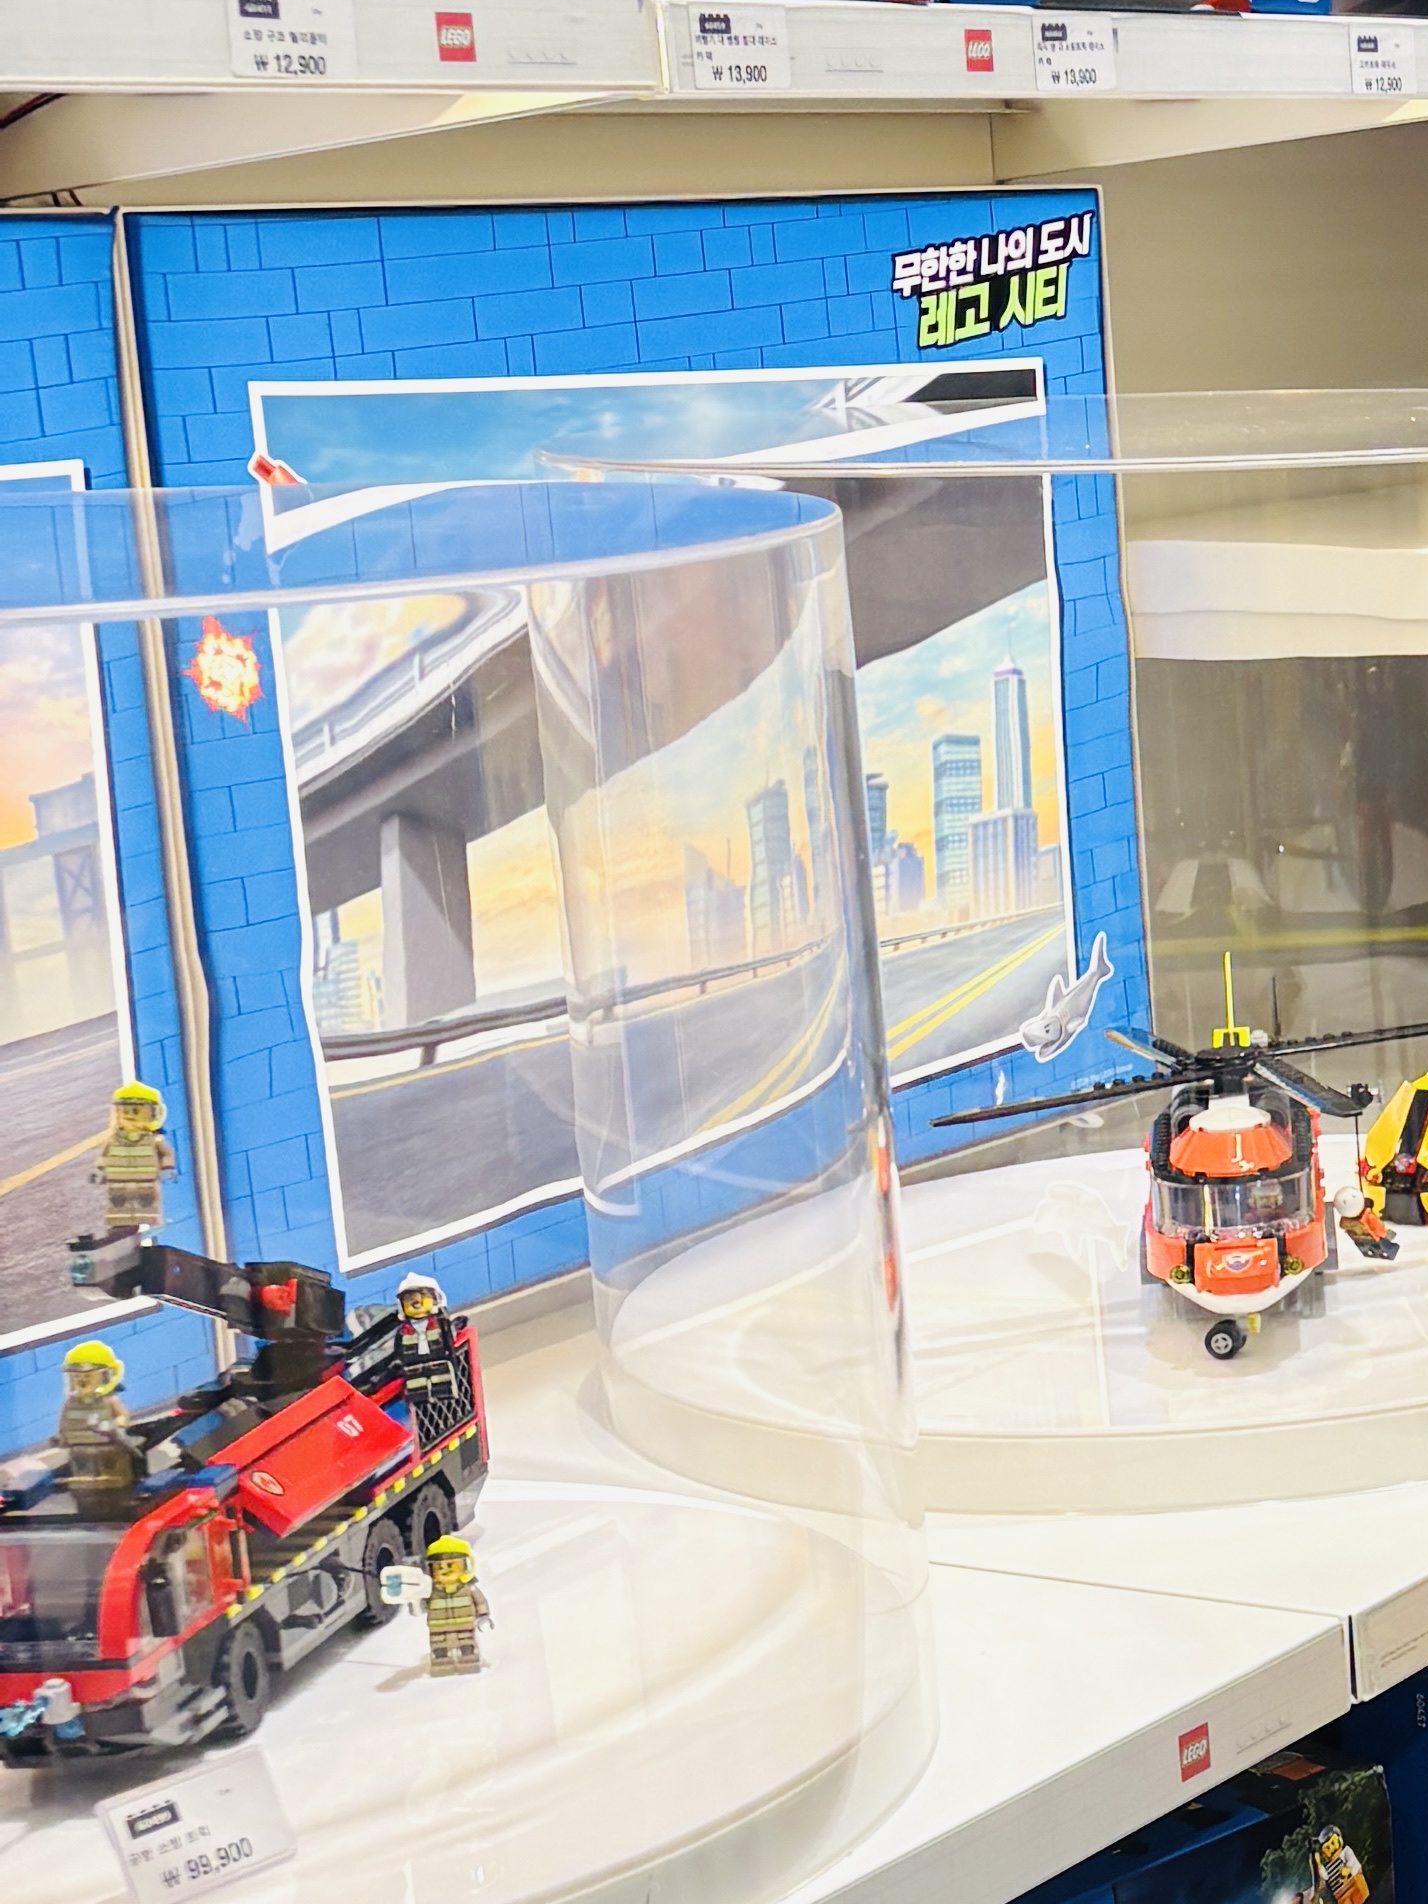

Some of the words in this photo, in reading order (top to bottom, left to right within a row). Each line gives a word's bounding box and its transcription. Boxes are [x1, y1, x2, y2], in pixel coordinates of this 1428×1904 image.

[439, 25, 471, 48] LEGO
[273, 53, 327, 76] 12,900
[727, 64, 768, 85] 13,900
[1064, 68, 1098, 88] 13,900
[892, 239, 978, 298] 무한한
[980, 225, 1035, 277] 나의
[1038, 212, 1094, 265] 도시
[918, 281, 991, 348] 레고
[999, 262, 1070, 329] 시티
[186, 1836, 254, 1880] 99,900
